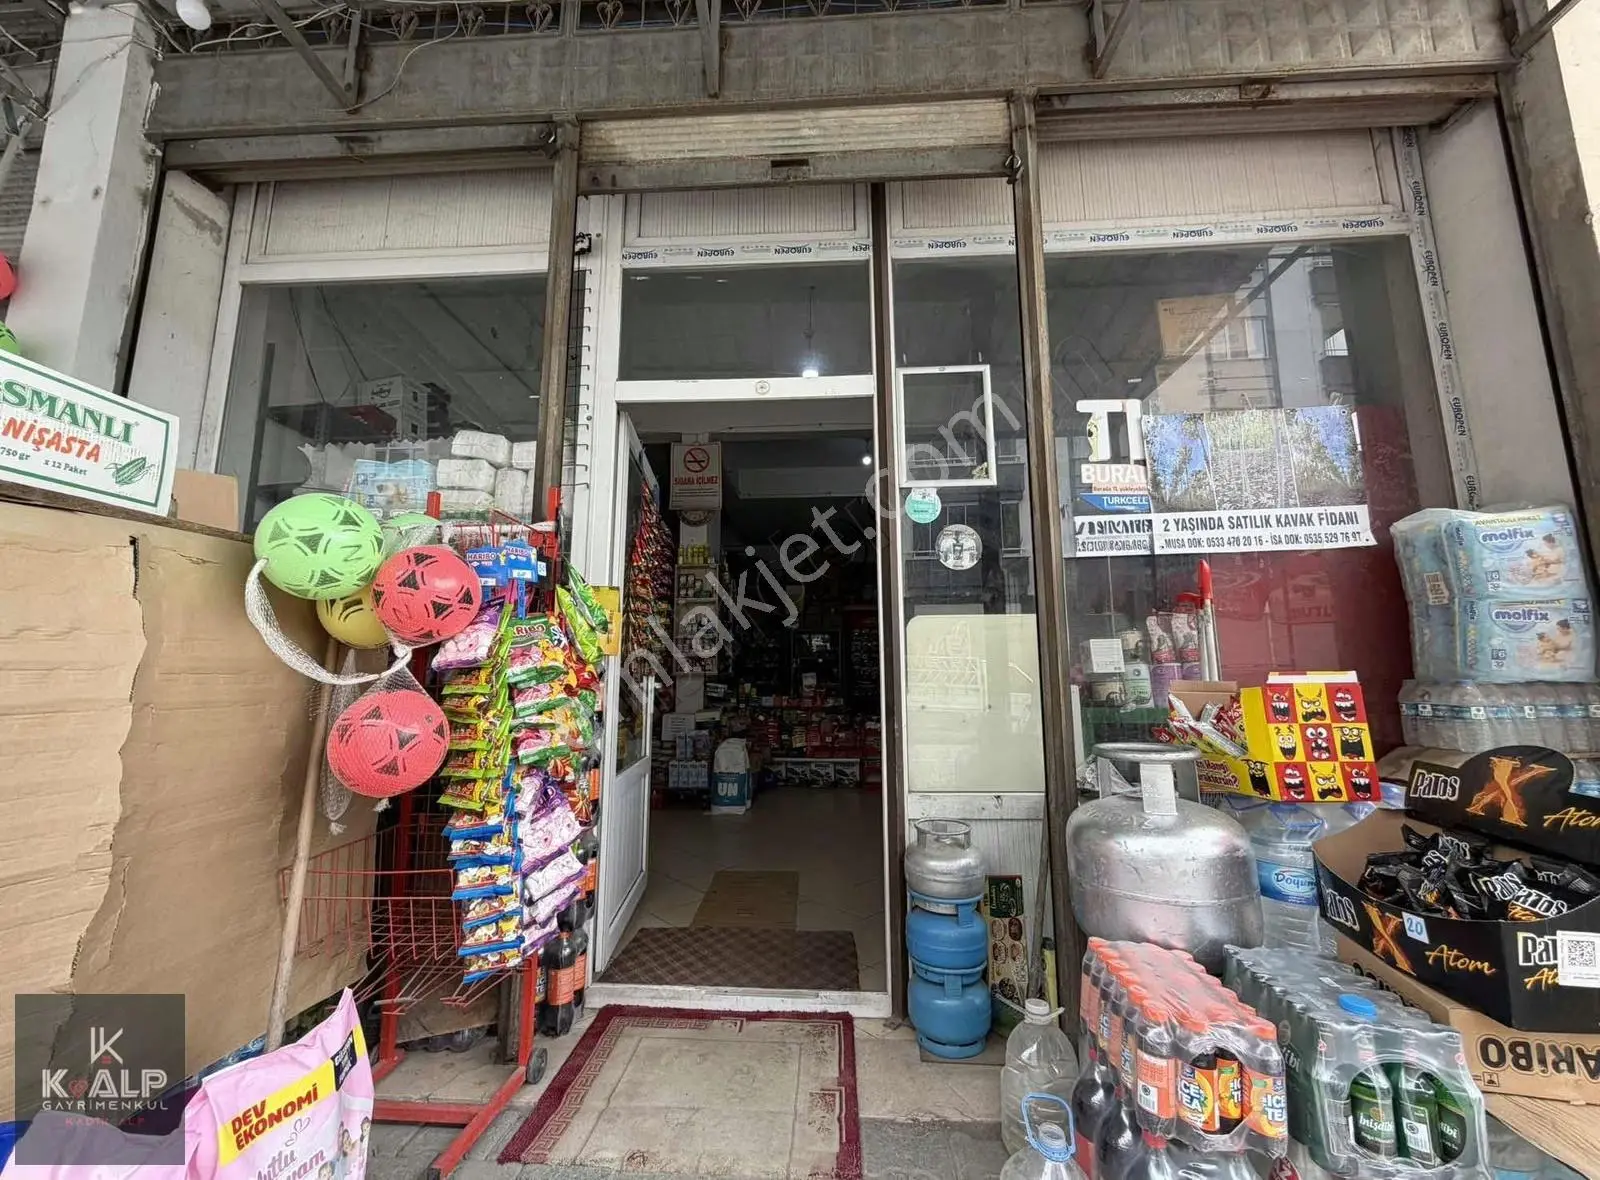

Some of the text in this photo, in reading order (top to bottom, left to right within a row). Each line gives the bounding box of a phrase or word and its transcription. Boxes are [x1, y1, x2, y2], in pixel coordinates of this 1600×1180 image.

[1412, 180, 1425, 216] EUROPEN
[1256, 225, 1298, 233] EUROPEN
[1341, 220, 1385, 229] EUROPEN
[1089, 234, 1130, 242] EUROPEN
[1172, 229, 1214, 238] EUROPEN
[697, 249, 734, 257] EUROPEN
[774, 246, 812, 254] EUROPEN
[927, 241, 967, 249] EUROPEN
[621, 252, 658, 260] EUROPEN
[1424, 250, 1438, 287] EUROPEN
[1438, 322, 1453, 360] EUROPEN
[0, 379, 133, 444] SMANLI
[1452, 397, 1467, 436] EUROPEN
[2, 416, 101, 463] NİŞASTA
[51, 459, 62, 469] 12
[64, 463, 88, 476] Paket
[1081, 463, 1147, 484] BURA
[1102, 496, 1149, 509] TURKCELL
[1162, 518, 1170, 532] 2
[1173, 516, 1225, 535] YAŞINDA
[1228, 513, 1272, 530] SATILIK
[1275, 512, 1315, 527] KAVAK
[1317, 508, 1359, 526] FİDANI
[1164, 538, 1187, 549] MUSA
[1206, 536, 1225, 548] 0533
[1243, 535, 1252, 546] 20
[1304, 532, 1323, 544] 0535
[1340, 532, 1350, 543] 76
[1481, 527, 1535, 543] molfix
[466, 552, 497, 561] HARIBO
[1493, 607, 1550, 622] molfix
[513, 623, 546, 637] RIBO
[717, 782, 739, 797] UN
[1406, 917, 1424, 936] 20
[1425, 943, 1496, 975] Atom
[1523, 967, 1560, 991] At
[1480, 1037, 1600, 1081] ARIBO
[231, 1099, 267, 1136] DEV
[235, 1083, 319, 1151] EKONOMİ
